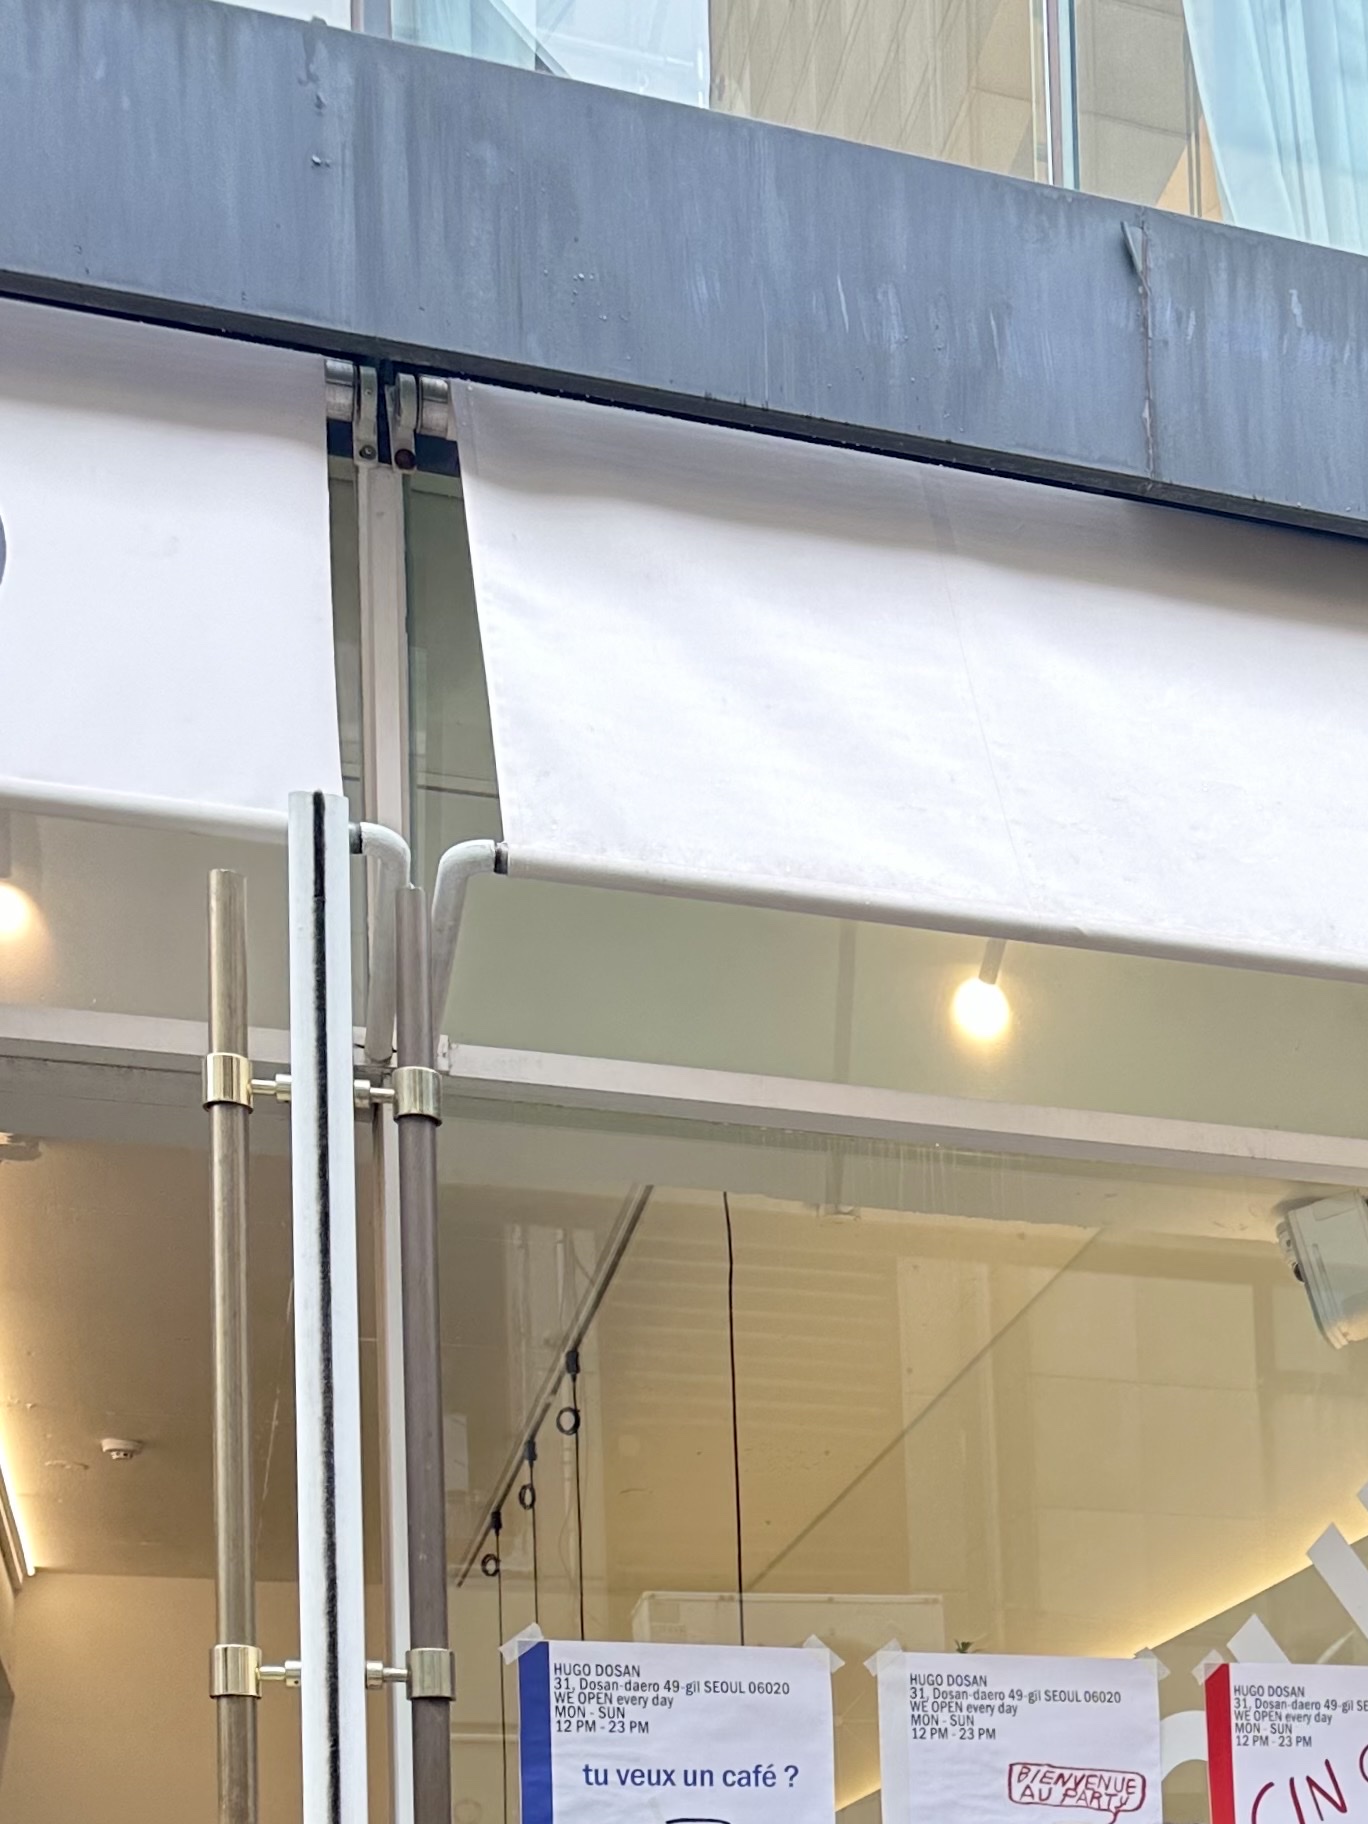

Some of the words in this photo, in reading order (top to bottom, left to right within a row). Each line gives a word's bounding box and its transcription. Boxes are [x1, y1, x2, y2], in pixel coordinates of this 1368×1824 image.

[553, 1662, 591, 1677] HUGO
[595, 1664, 641, 1678] DOSAN
[553, 1677, 576, 1693] 31,
[579, 1678, 660, 1693] Dosan-daero
[663, 1680, 701, 1696] 49-gil
[703, 1680, 746, 1694] SEOUL
[748, 1681, 790, 1695] 06020
[909, 1673, 944, 1686] HUGO
[946, 1674, 988, 1687] DOSAN
[909, 1687, 929, 1701] 31,
[933, 1687, 1005, 1701] Dosan-daero
[1008, 1689, 1042, 1705] 49-gil
[1044, 1690, 1081, 1703] SEOUL
[1083, 1690, 1122, 1704] 06020
[1234, 1685, 1265, 1697] HUGO
[1267, 1686, 1305, 1698] DOSAN
[554, 1692, 576, 1705] WE
[577, 1692, 613, 1706] OPEN
[616, 1695, 648, 1709] every
[651, 1693, 674, 1709] day
[1234, 1697, 1251, 1710] 31,
[1255, 1698, 1321, 1711] Dosan-daero
[1323, 1699, 1354, 1714] 49-gil
[554, 1706, 586, 1718] MON
[598, 1706, 625, 1719] SUN
[910, 1700, 929, 1713] WE
[931, 1700, 963, 1714] OPEN
[966, 1704, 995, 1717] every
[997, 1702, 1018, 1717] day
[910, 1714, 939, 1726] MON
[950, 1714, 975, 1727] SUN
[1234, 1710, 1251, 1722] WE
[1253, 1710, 1282, 1722] OPEN
[1285, 1714, 1311, 1725] every
[1314, 1712, 1333, 1725] day
[555, 1720, 572, 1733] 12
[576, 1720, 596, 1733] PM
[608, 1721, 625, 1733] 23
[629, 1721, 649, 1734] PM
[912, 1727, 926, 1740] 12
[930, 1727, 948, 1740] PM
[959, 1727, 975, 1740] 23
[978, 1728, 997, 1740] PM
[1235, 1722, 1260, 1734] MON
[1270, 1723, 1293, 1735] SUN
[1236, 1735, 1249, 1746] 12
[1252, 1735, 1269, 1747] PM
[1278, 1735, 1293, 1747] 23
[1295, 1736, 1312, 1747] PM
[582, 1763, 609, 1786] tu
[616, 1768, 676, 1786] veux
[683, 1768, 714, 1787] un
[722, 1763, 777, 1788] café
[784, 1764, 800, 1788] ?
[1017, 1765, 1137, 1794] BIENVENUE
[1020, 1784, 1052, 1801] AU
[1061, 1787, 1129, 1810] PARTY
